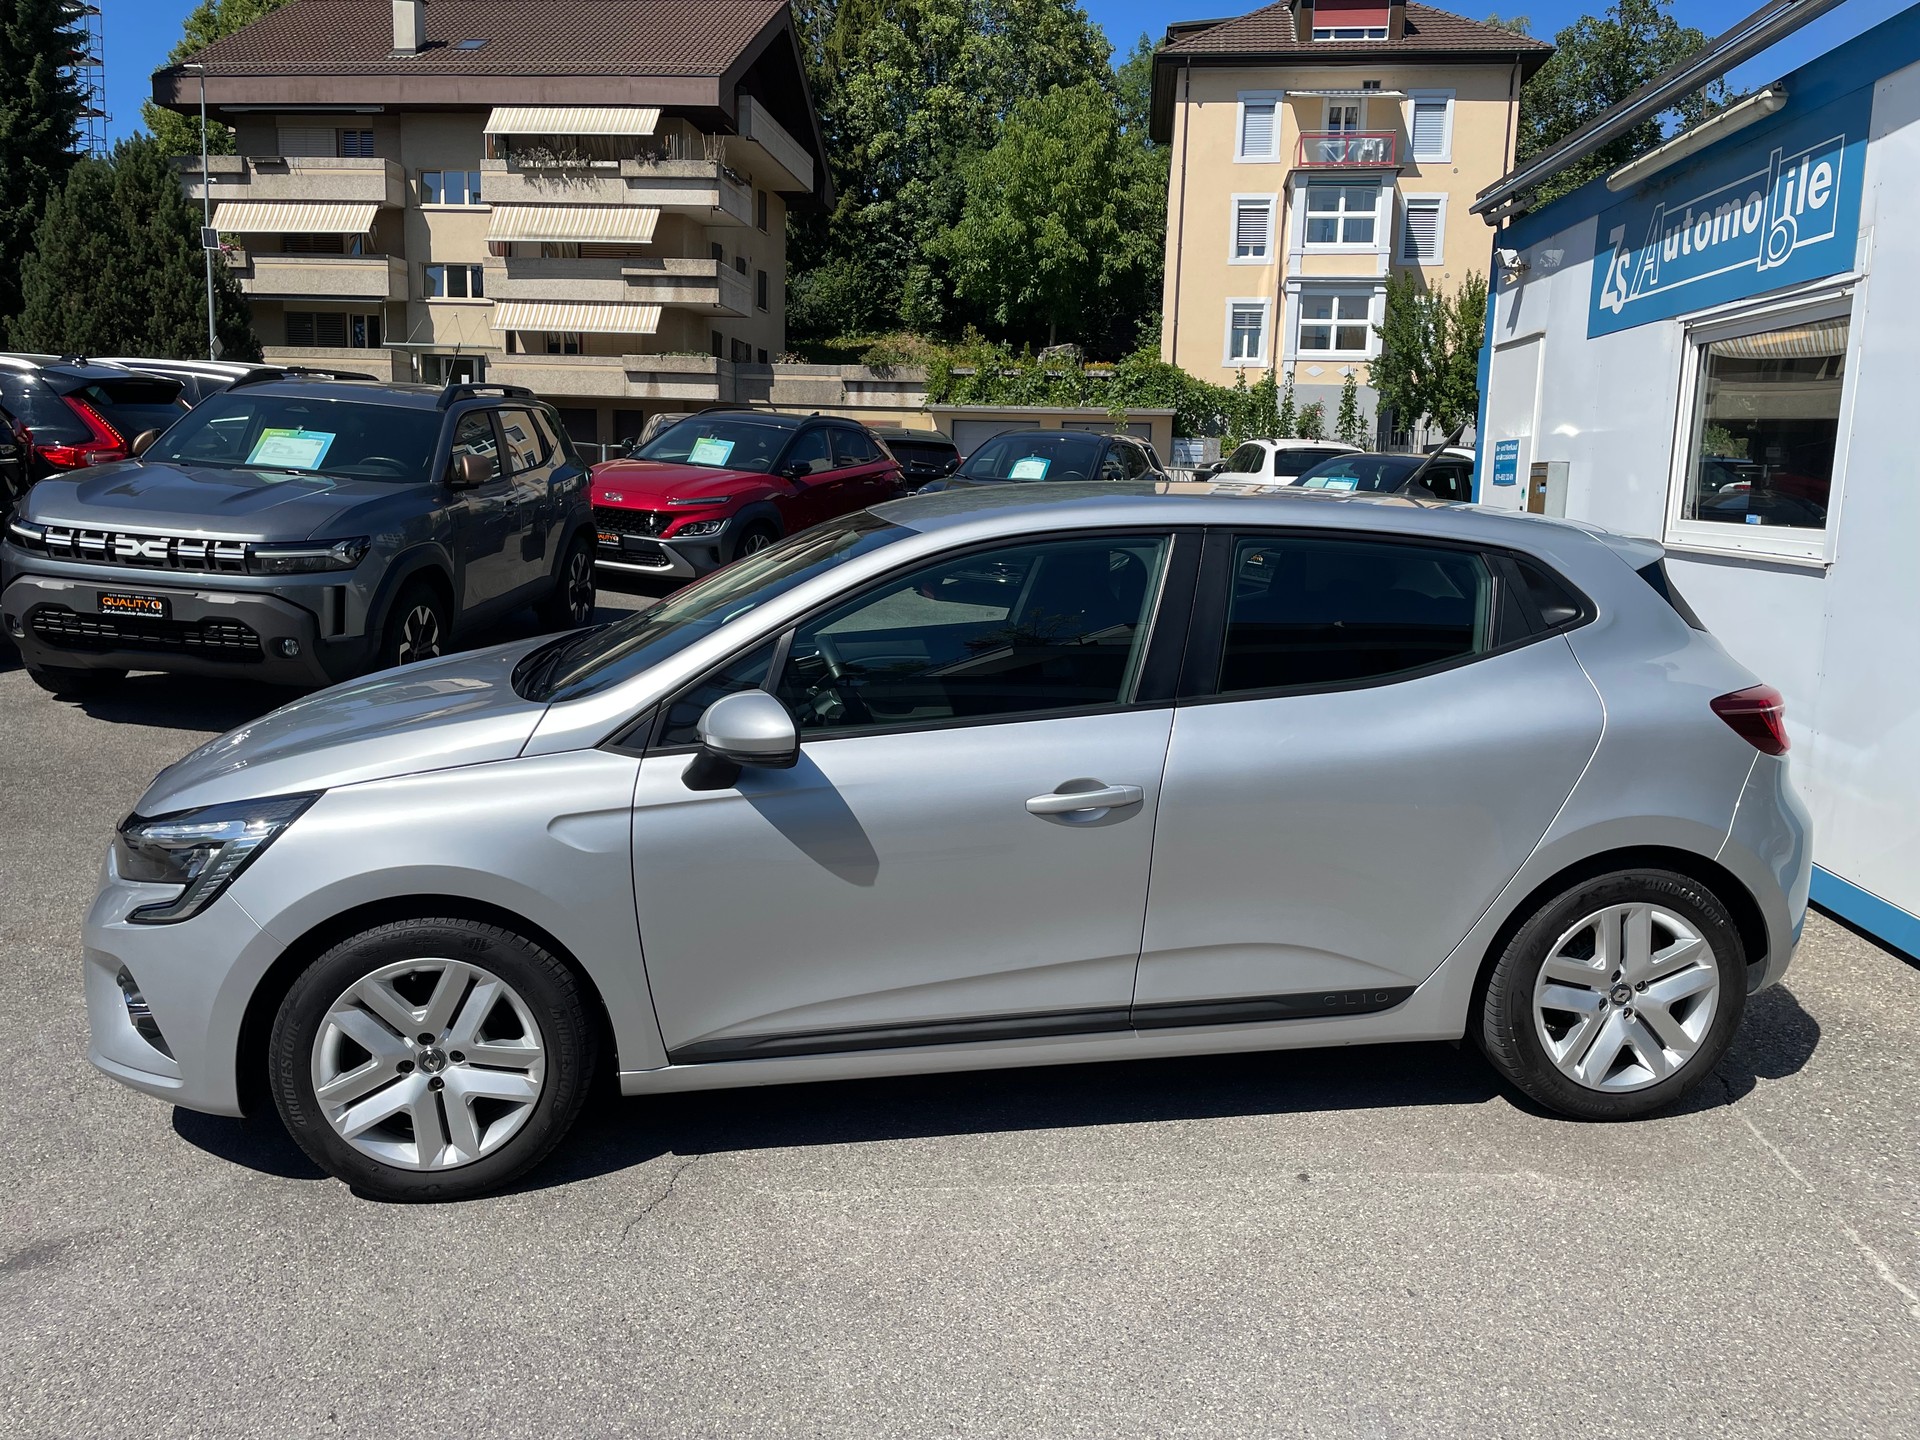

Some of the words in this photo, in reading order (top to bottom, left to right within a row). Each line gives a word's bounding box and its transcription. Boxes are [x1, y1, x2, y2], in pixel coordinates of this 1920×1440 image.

[102, 597, 151, 608] QUALITY
[1644, 879, 1726, 928] BRIDGESTONE
[1323, 991, 1389, 1006] CLIO
[280, 1020, 308, 1128] BRIDGESTONE
